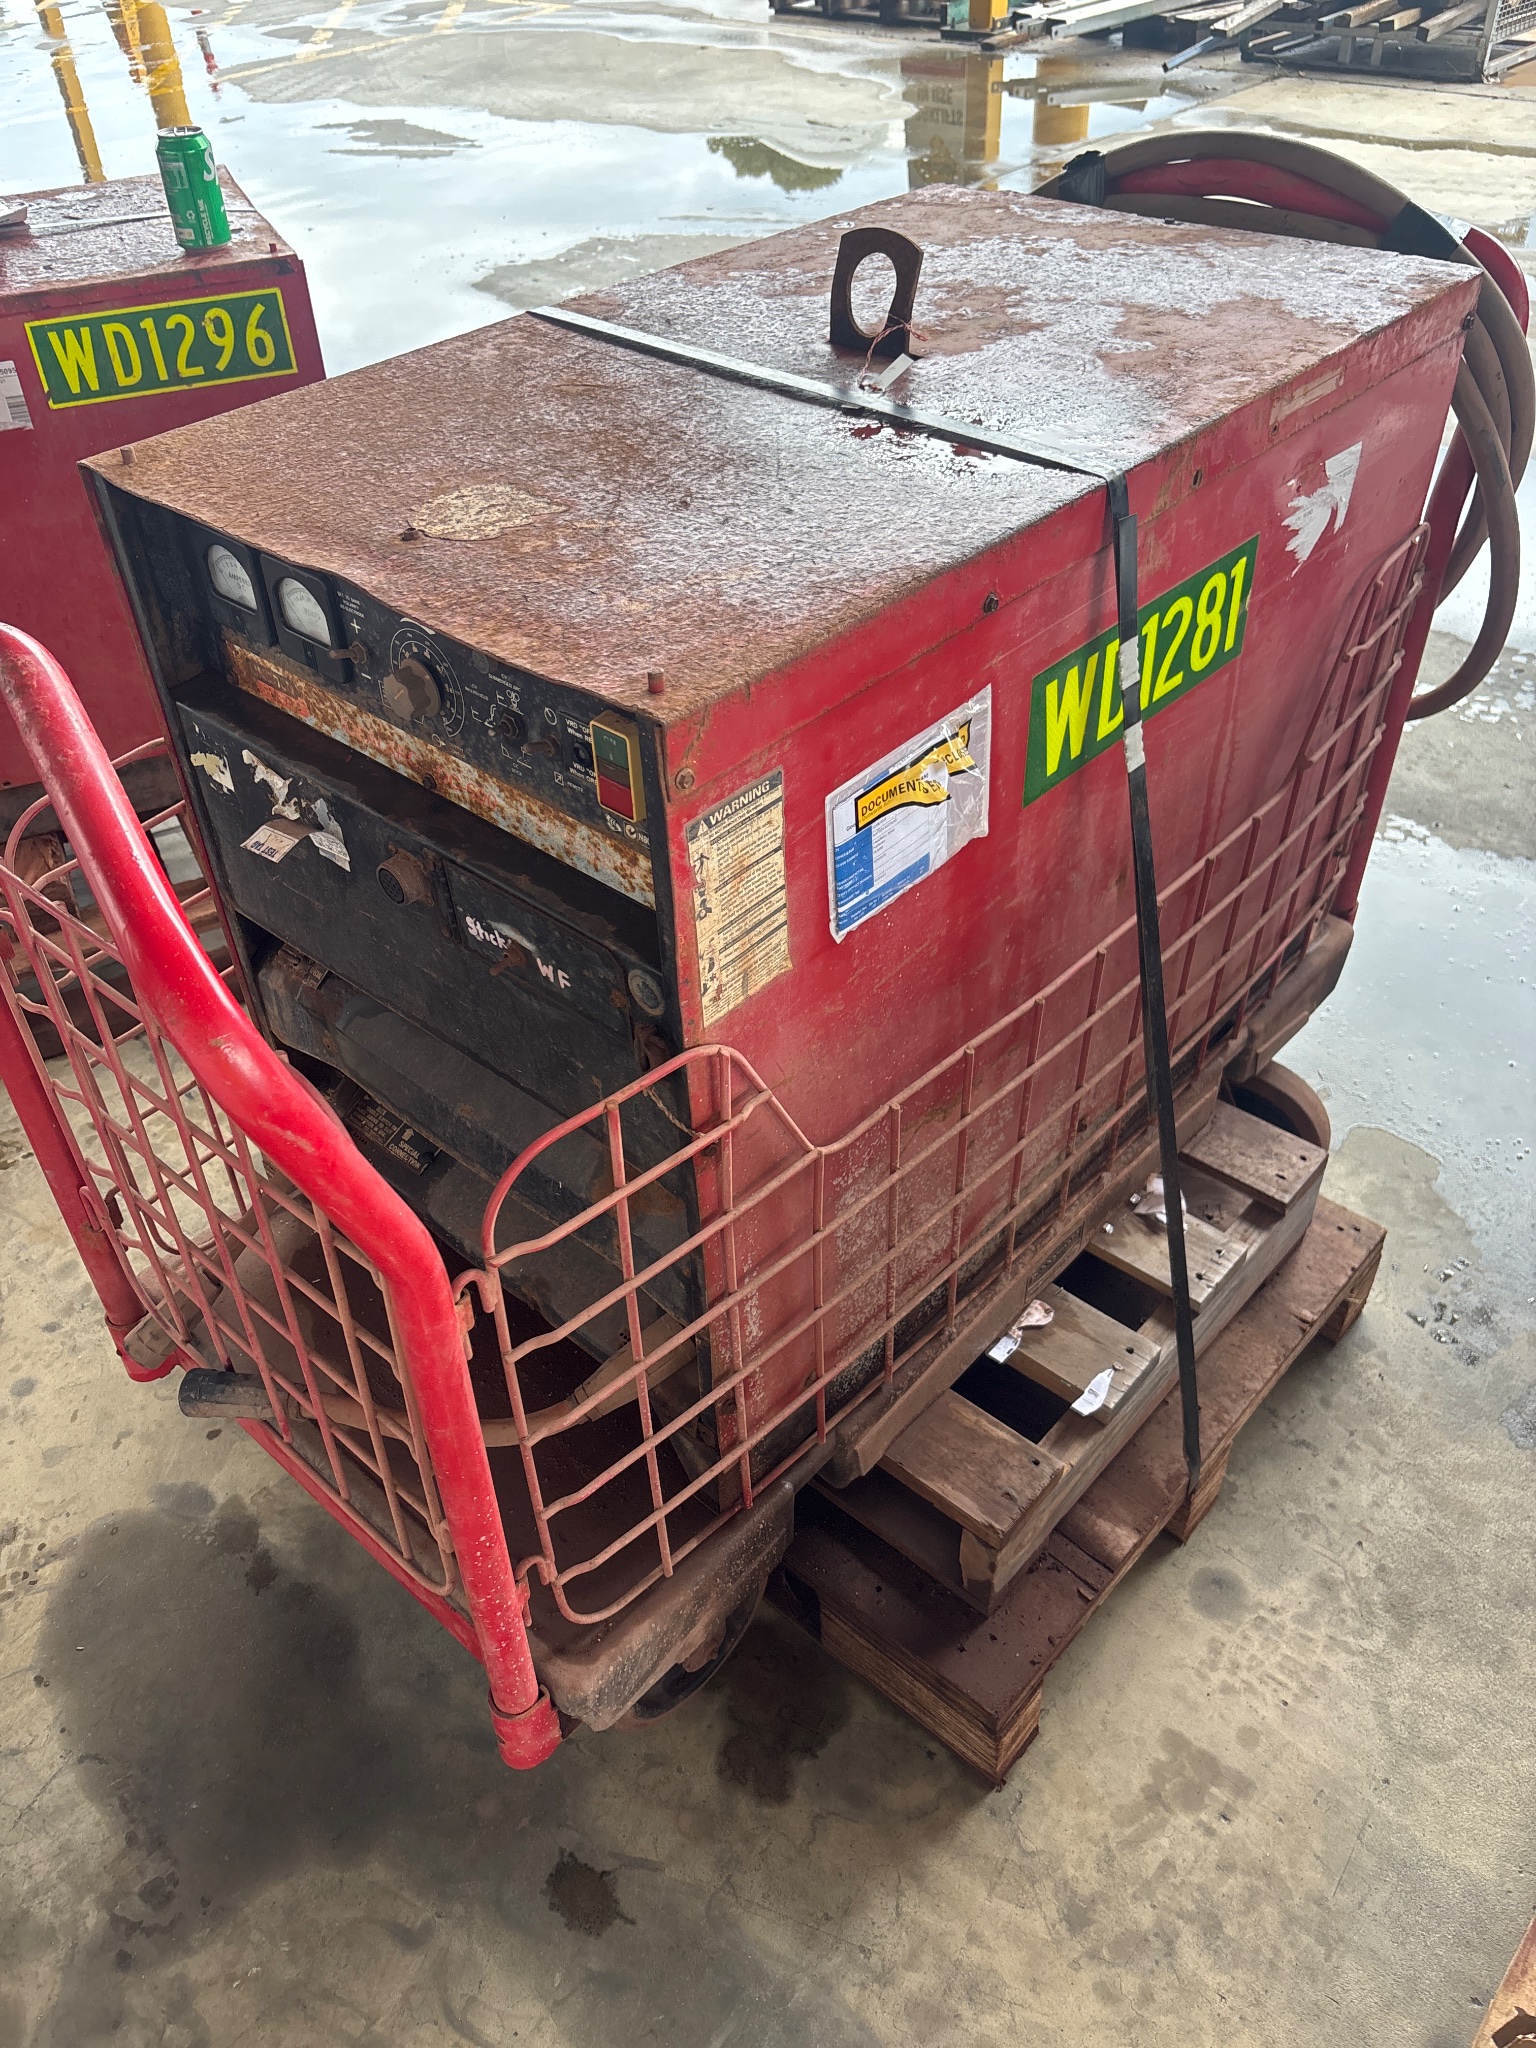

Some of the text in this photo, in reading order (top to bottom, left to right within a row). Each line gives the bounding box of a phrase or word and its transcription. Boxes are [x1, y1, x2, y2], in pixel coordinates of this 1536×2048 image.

[201, 212, 213, 245] RECYCLE
[47, 303, 275, 394] WD1296
[565, 718, 578, 729] VRD
[567, 726, 583, 739] When
[709, 780, 770, 826] WARNING
[861, 778, 929, 817] DOCUMENTS
[388, 1143, 421, 1169] CONNECTION
[399, 1140, 420, 1160] SPECIAL
